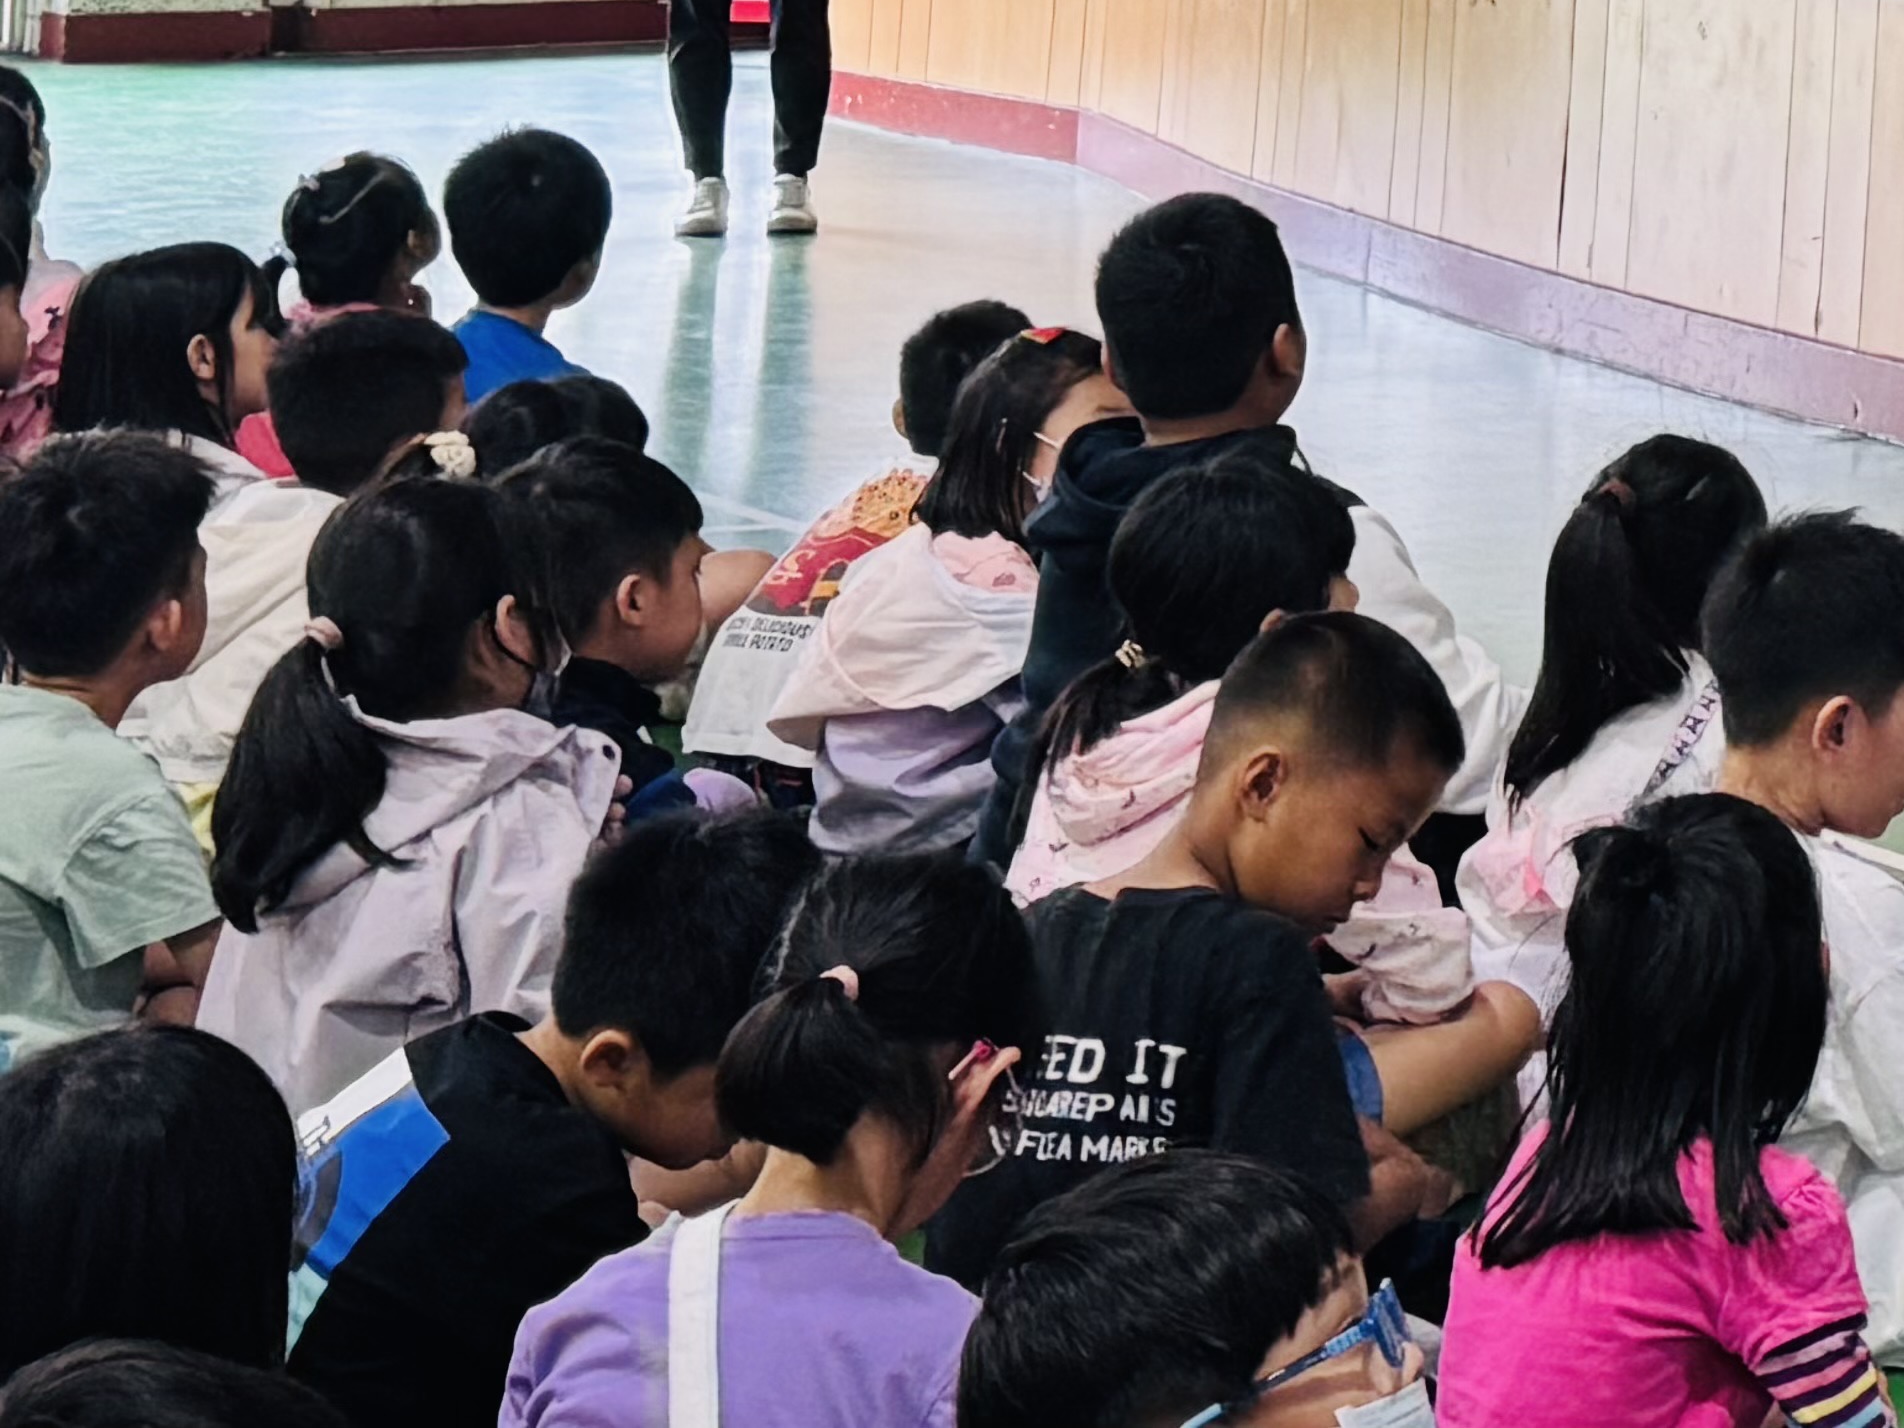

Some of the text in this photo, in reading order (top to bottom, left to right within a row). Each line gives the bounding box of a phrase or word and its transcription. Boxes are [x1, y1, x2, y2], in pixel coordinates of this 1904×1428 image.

[1040, 1034, 1187, 1089] ED IT
[1015, 1130, 1071, 1162] FLEA
[1080, 1134, 1167, 1163] MARKE
